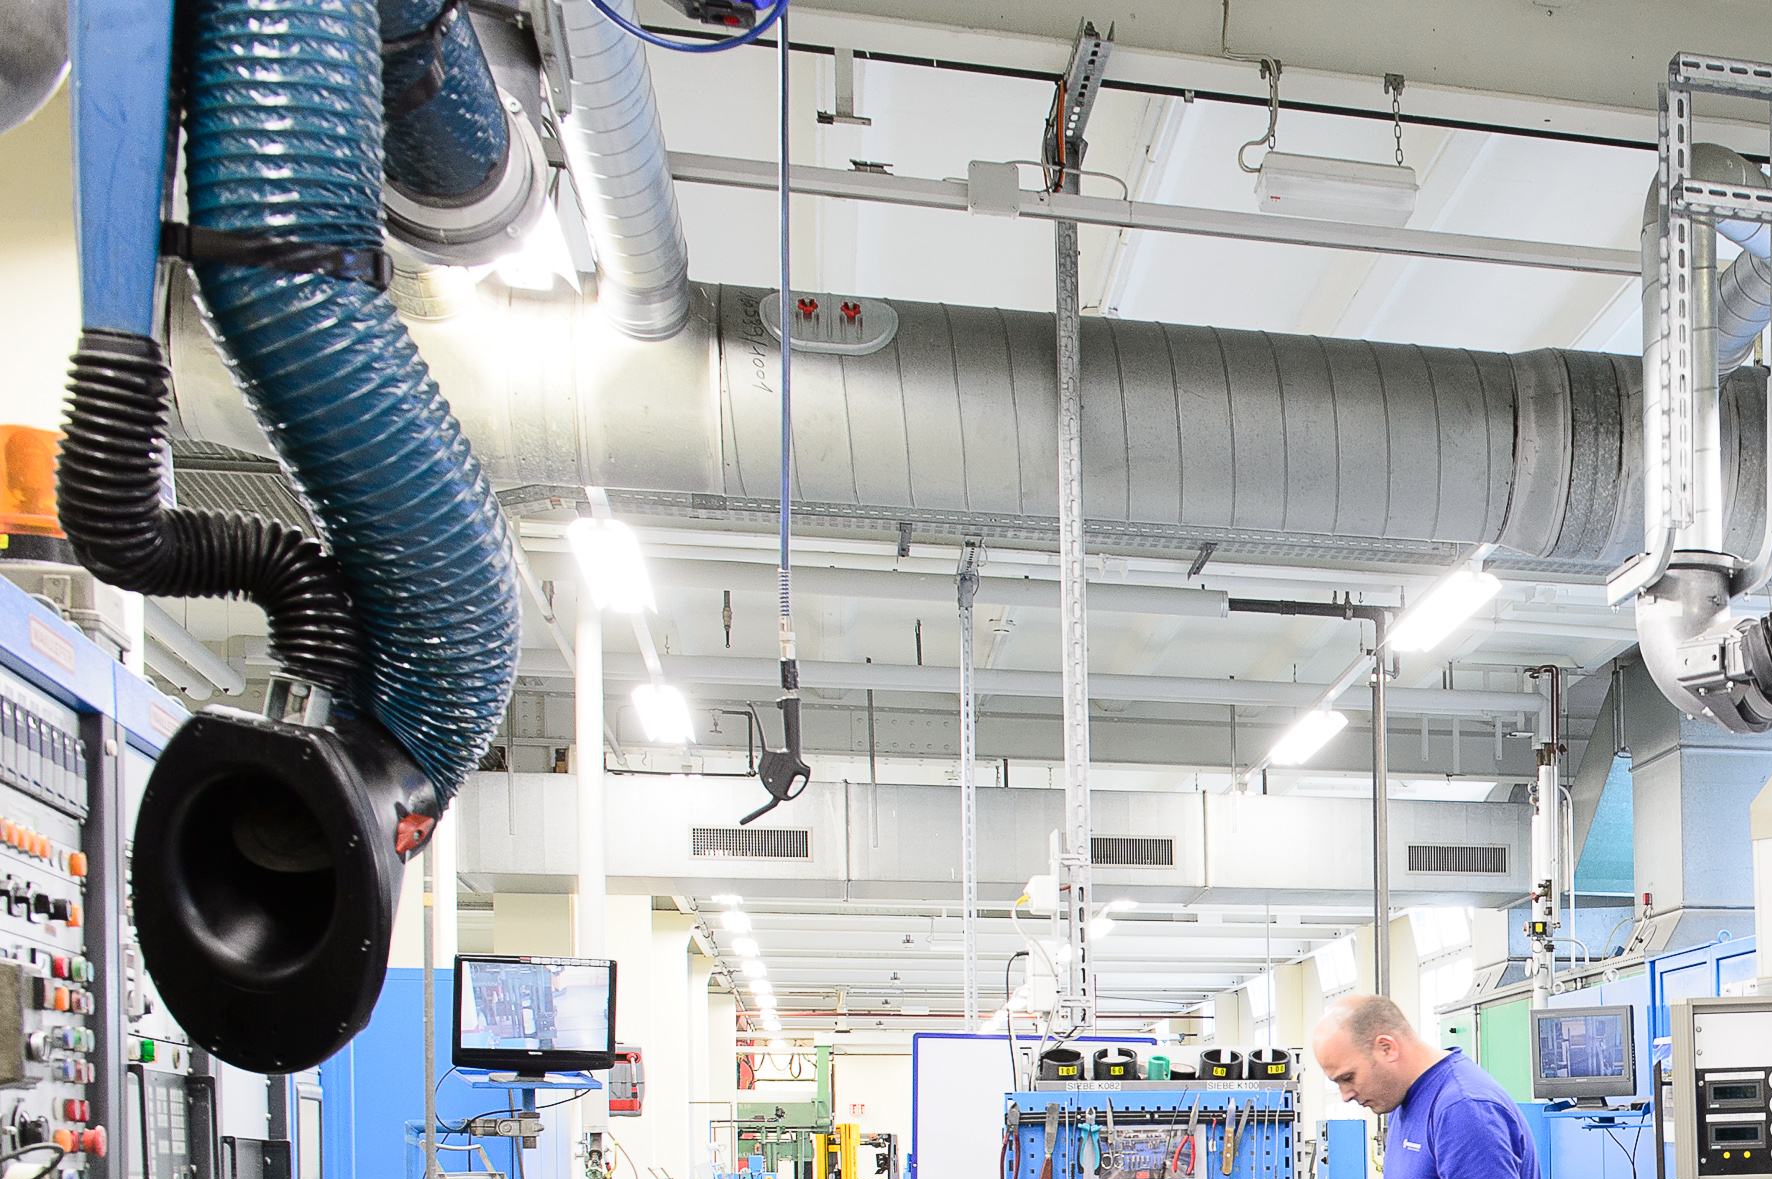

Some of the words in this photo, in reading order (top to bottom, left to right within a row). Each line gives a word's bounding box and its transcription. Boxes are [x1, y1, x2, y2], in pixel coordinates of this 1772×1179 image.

[1061, 1066, 1076, 1075] 100
[1112, 1066, 1122, 1074] 60
[1214, 1067, 1225, 1075] 60
[1269, 1065, 1285, 1073] 100
[1067, 1082, 1095, 1090] SIEBE
[1098, 1082, 1120, 1090] K082
[1207, 1082, 1234, 1090] SIEBE
[1238, 1082, 1259, 1090] K100
